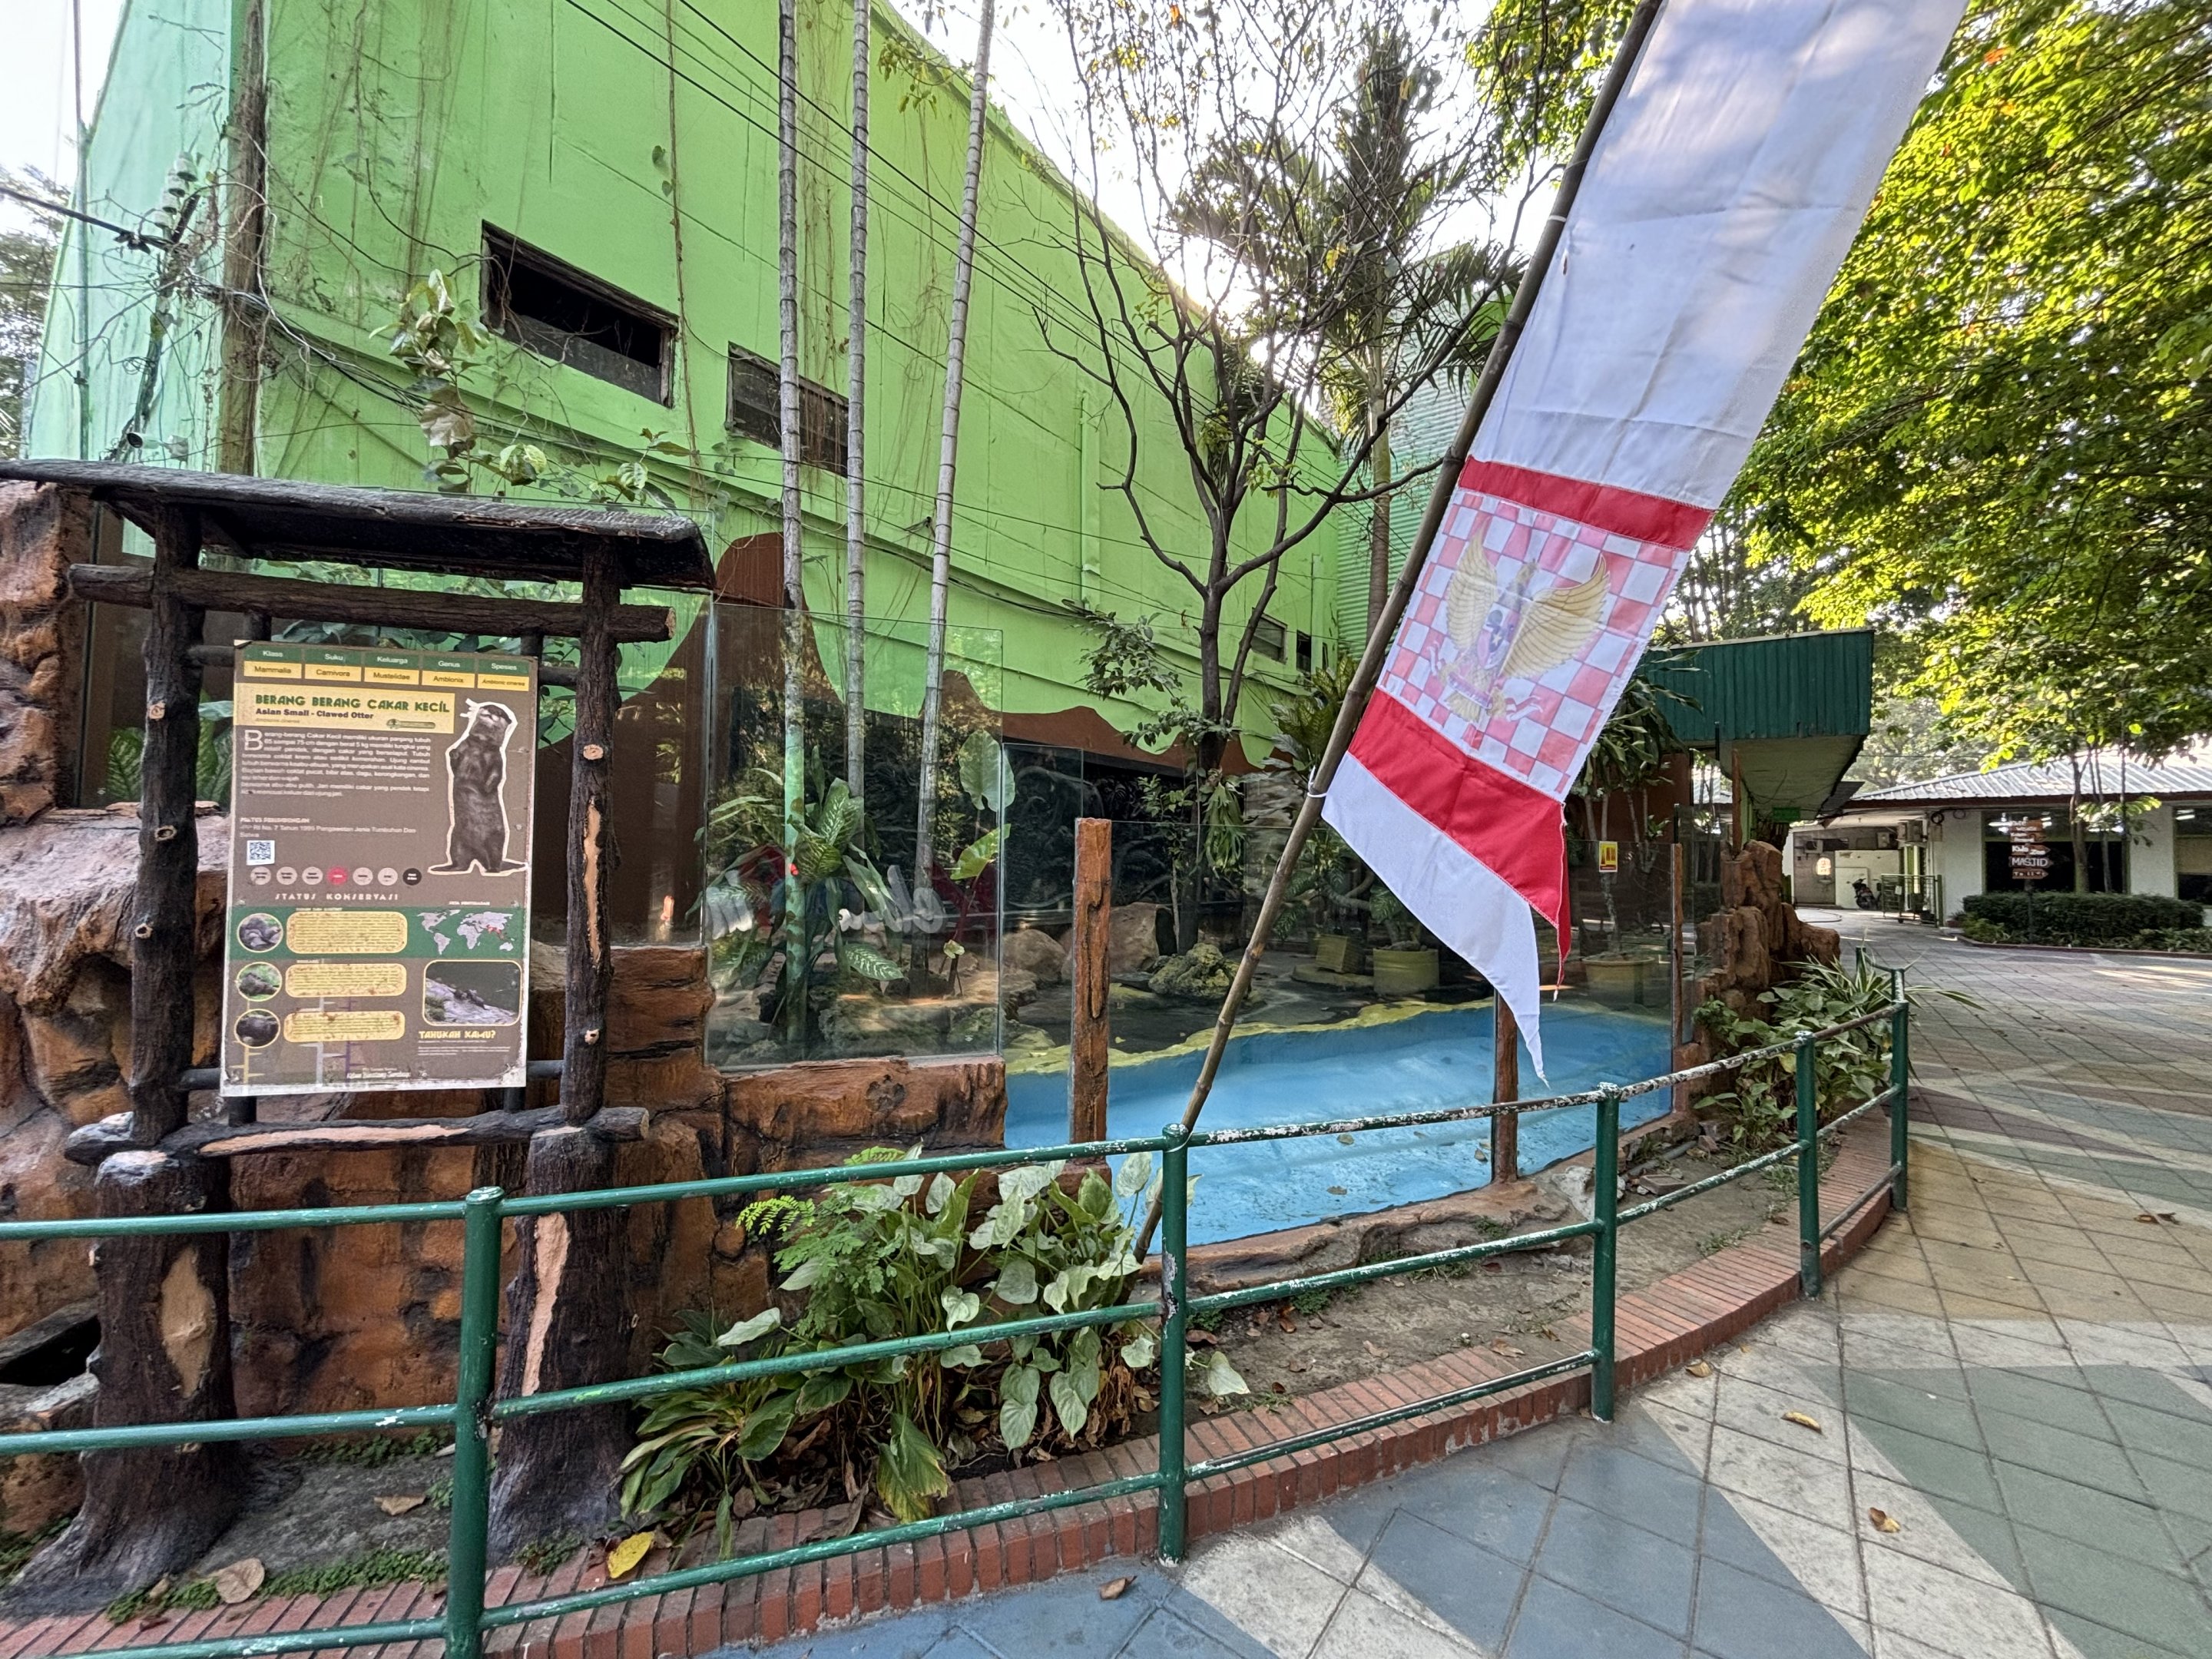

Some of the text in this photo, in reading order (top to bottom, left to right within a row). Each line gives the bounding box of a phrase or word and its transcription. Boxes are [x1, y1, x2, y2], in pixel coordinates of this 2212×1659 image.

[377, 656, 408, 664] Keluarga
[316, 669, 350, 677] Carnivora
[256, 694, 306, 706] BERANG
[312, 697, 361, 708] BERANG
[367, 700, 409, 710] CAKAR
[2012, 857, 2048, 867] MASJID
[419, 1030, 496, 1039] TAHUKAH KAMU?
